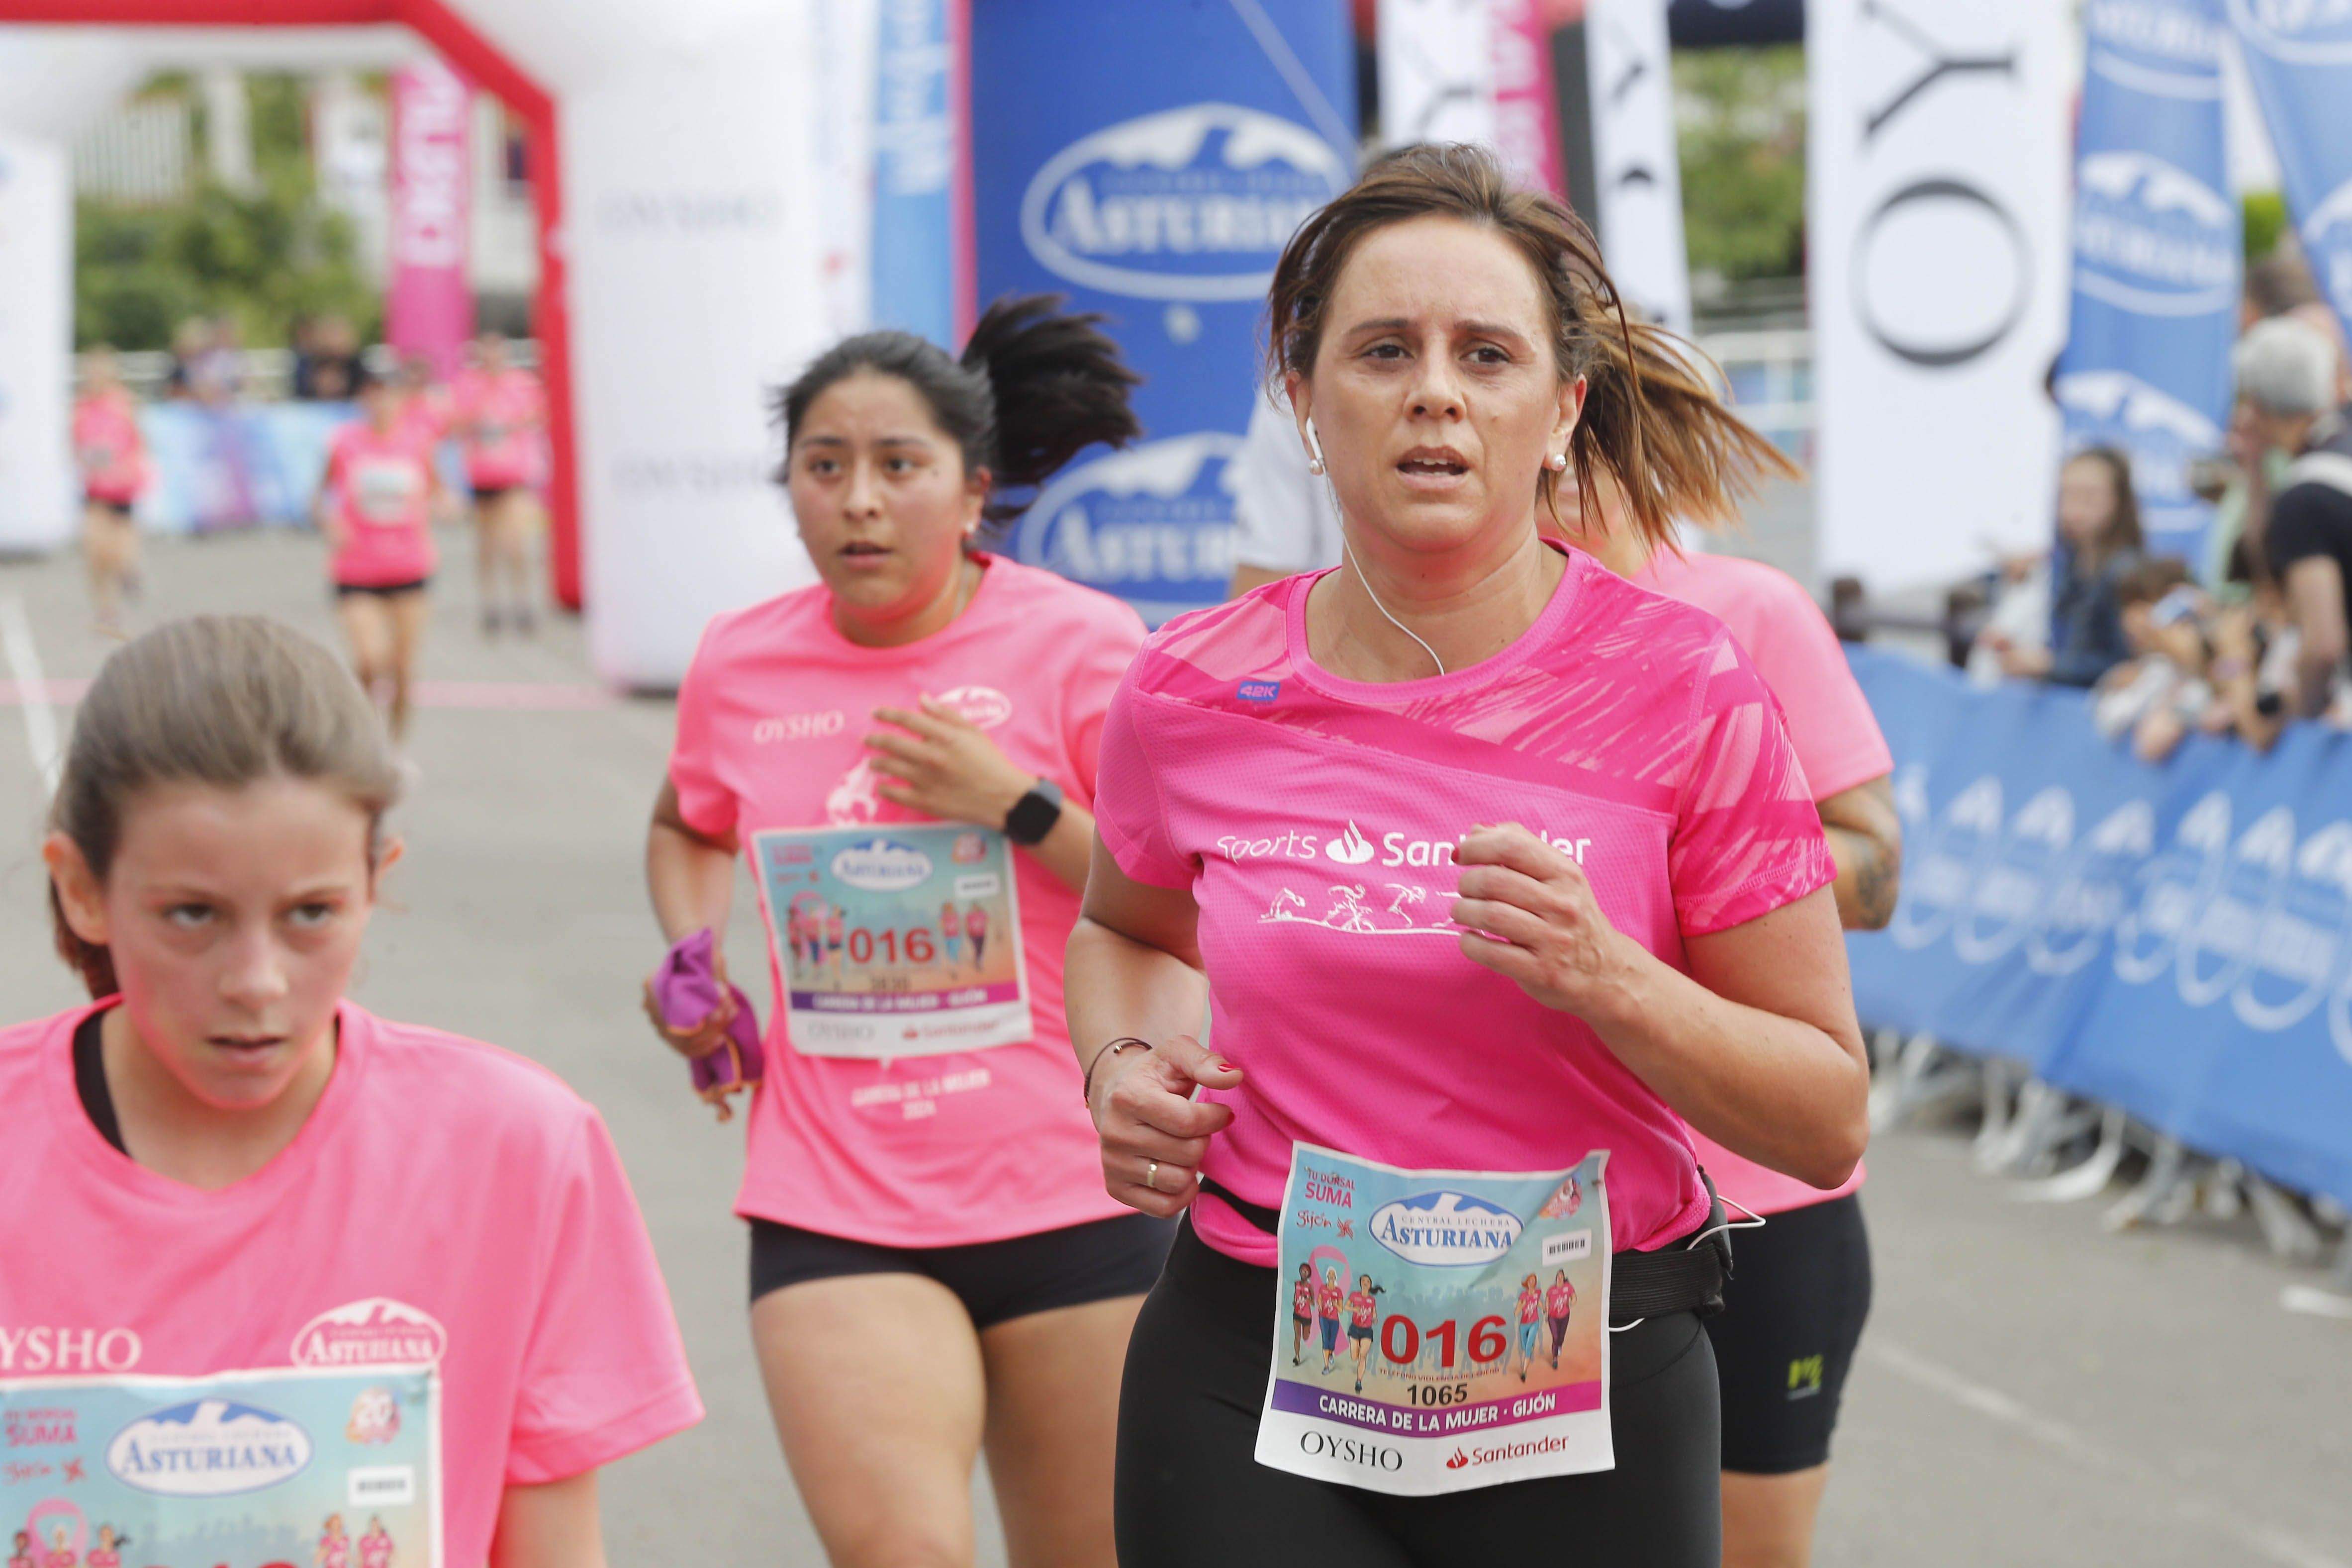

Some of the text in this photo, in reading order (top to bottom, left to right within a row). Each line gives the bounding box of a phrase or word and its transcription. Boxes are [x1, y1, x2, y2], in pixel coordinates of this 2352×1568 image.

[753, 710, 844, 744] OYSHO
[1382, 830, 1592, 868] Saner
[848, 927, 936, 964] 016
[1305, 1181, 1352, 1209] SUMA
[1320, 1173, 1356, 1192] DORSAL
[1380, 1213, 1513, 1250] ASTURIANA
[1401, 1216, 1510, 1227] CENTRAL LECHERA
[1381, 1313, 1507, 1368] 016
[1318, 1391, 1557, 1432] CARRERA DE LA MUJER GIJÓN
[1407, 1383, 1468, 1406] 1065
[122, 1438, 297, 1474] ASTURIANA
[1300, 1430, 1570, 1473] OYSHO Santander
